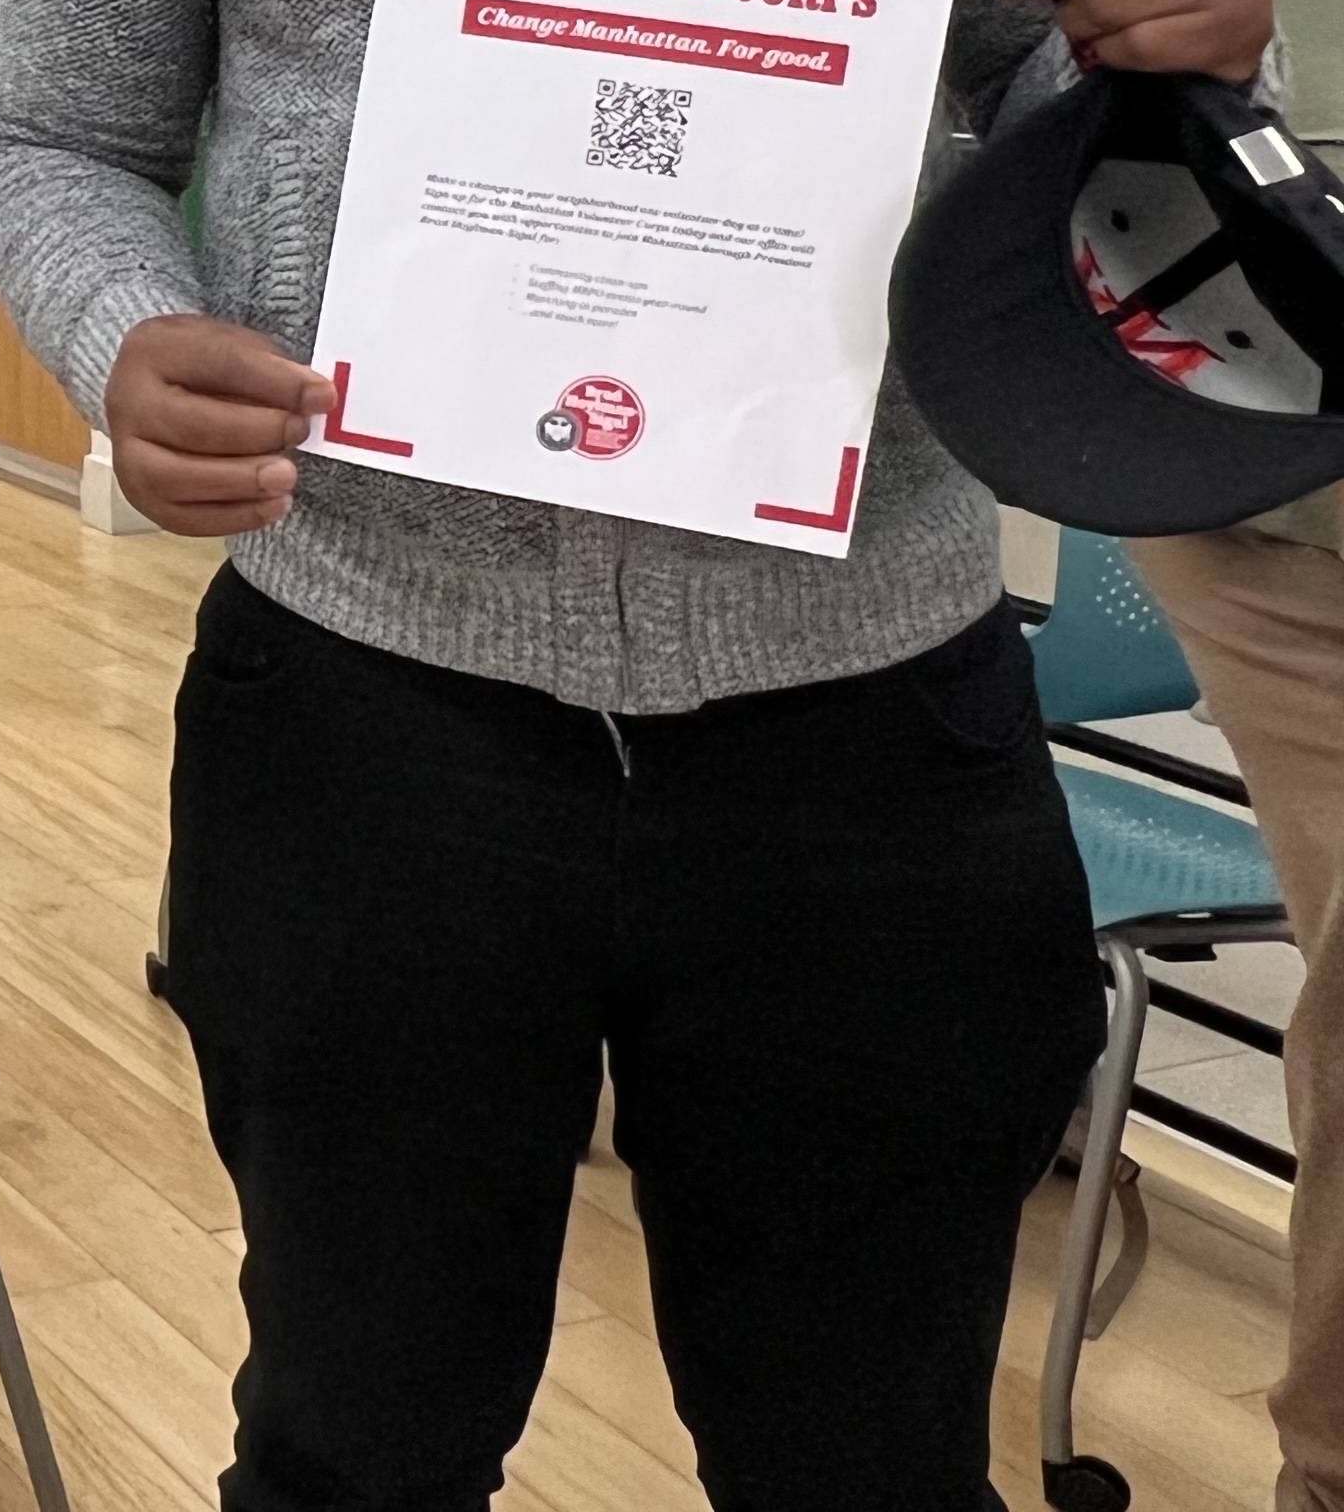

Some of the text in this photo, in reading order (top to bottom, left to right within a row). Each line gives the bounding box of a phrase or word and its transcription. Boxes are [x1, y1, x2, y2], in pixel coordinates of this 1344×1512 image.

[477, 6, 832, 72] Change Manhattan. For good.
